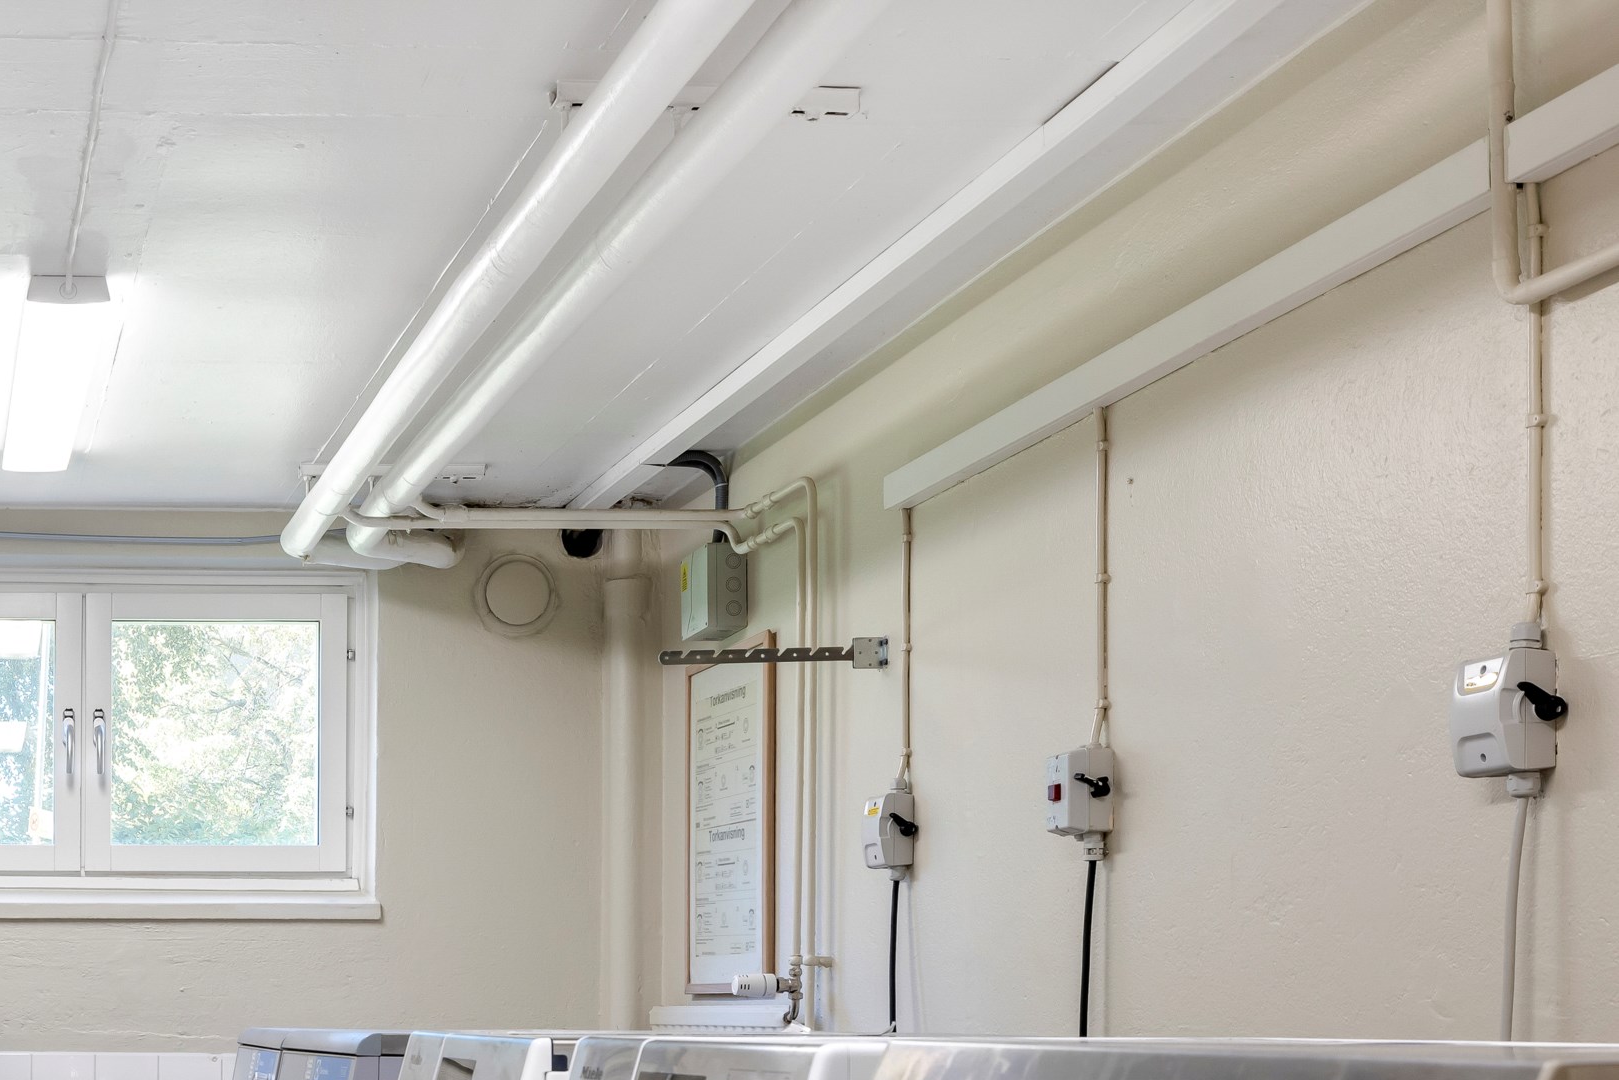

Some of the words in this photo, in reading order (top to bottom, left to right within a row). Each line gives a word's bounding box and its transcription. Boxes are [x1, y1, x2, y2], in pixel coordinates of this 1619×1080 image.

[710, 686, 746, 707] Torkanvisning
[709, 826, 745, 843] Torkanvisning
[580, 1065, 604, 1080] Miele
